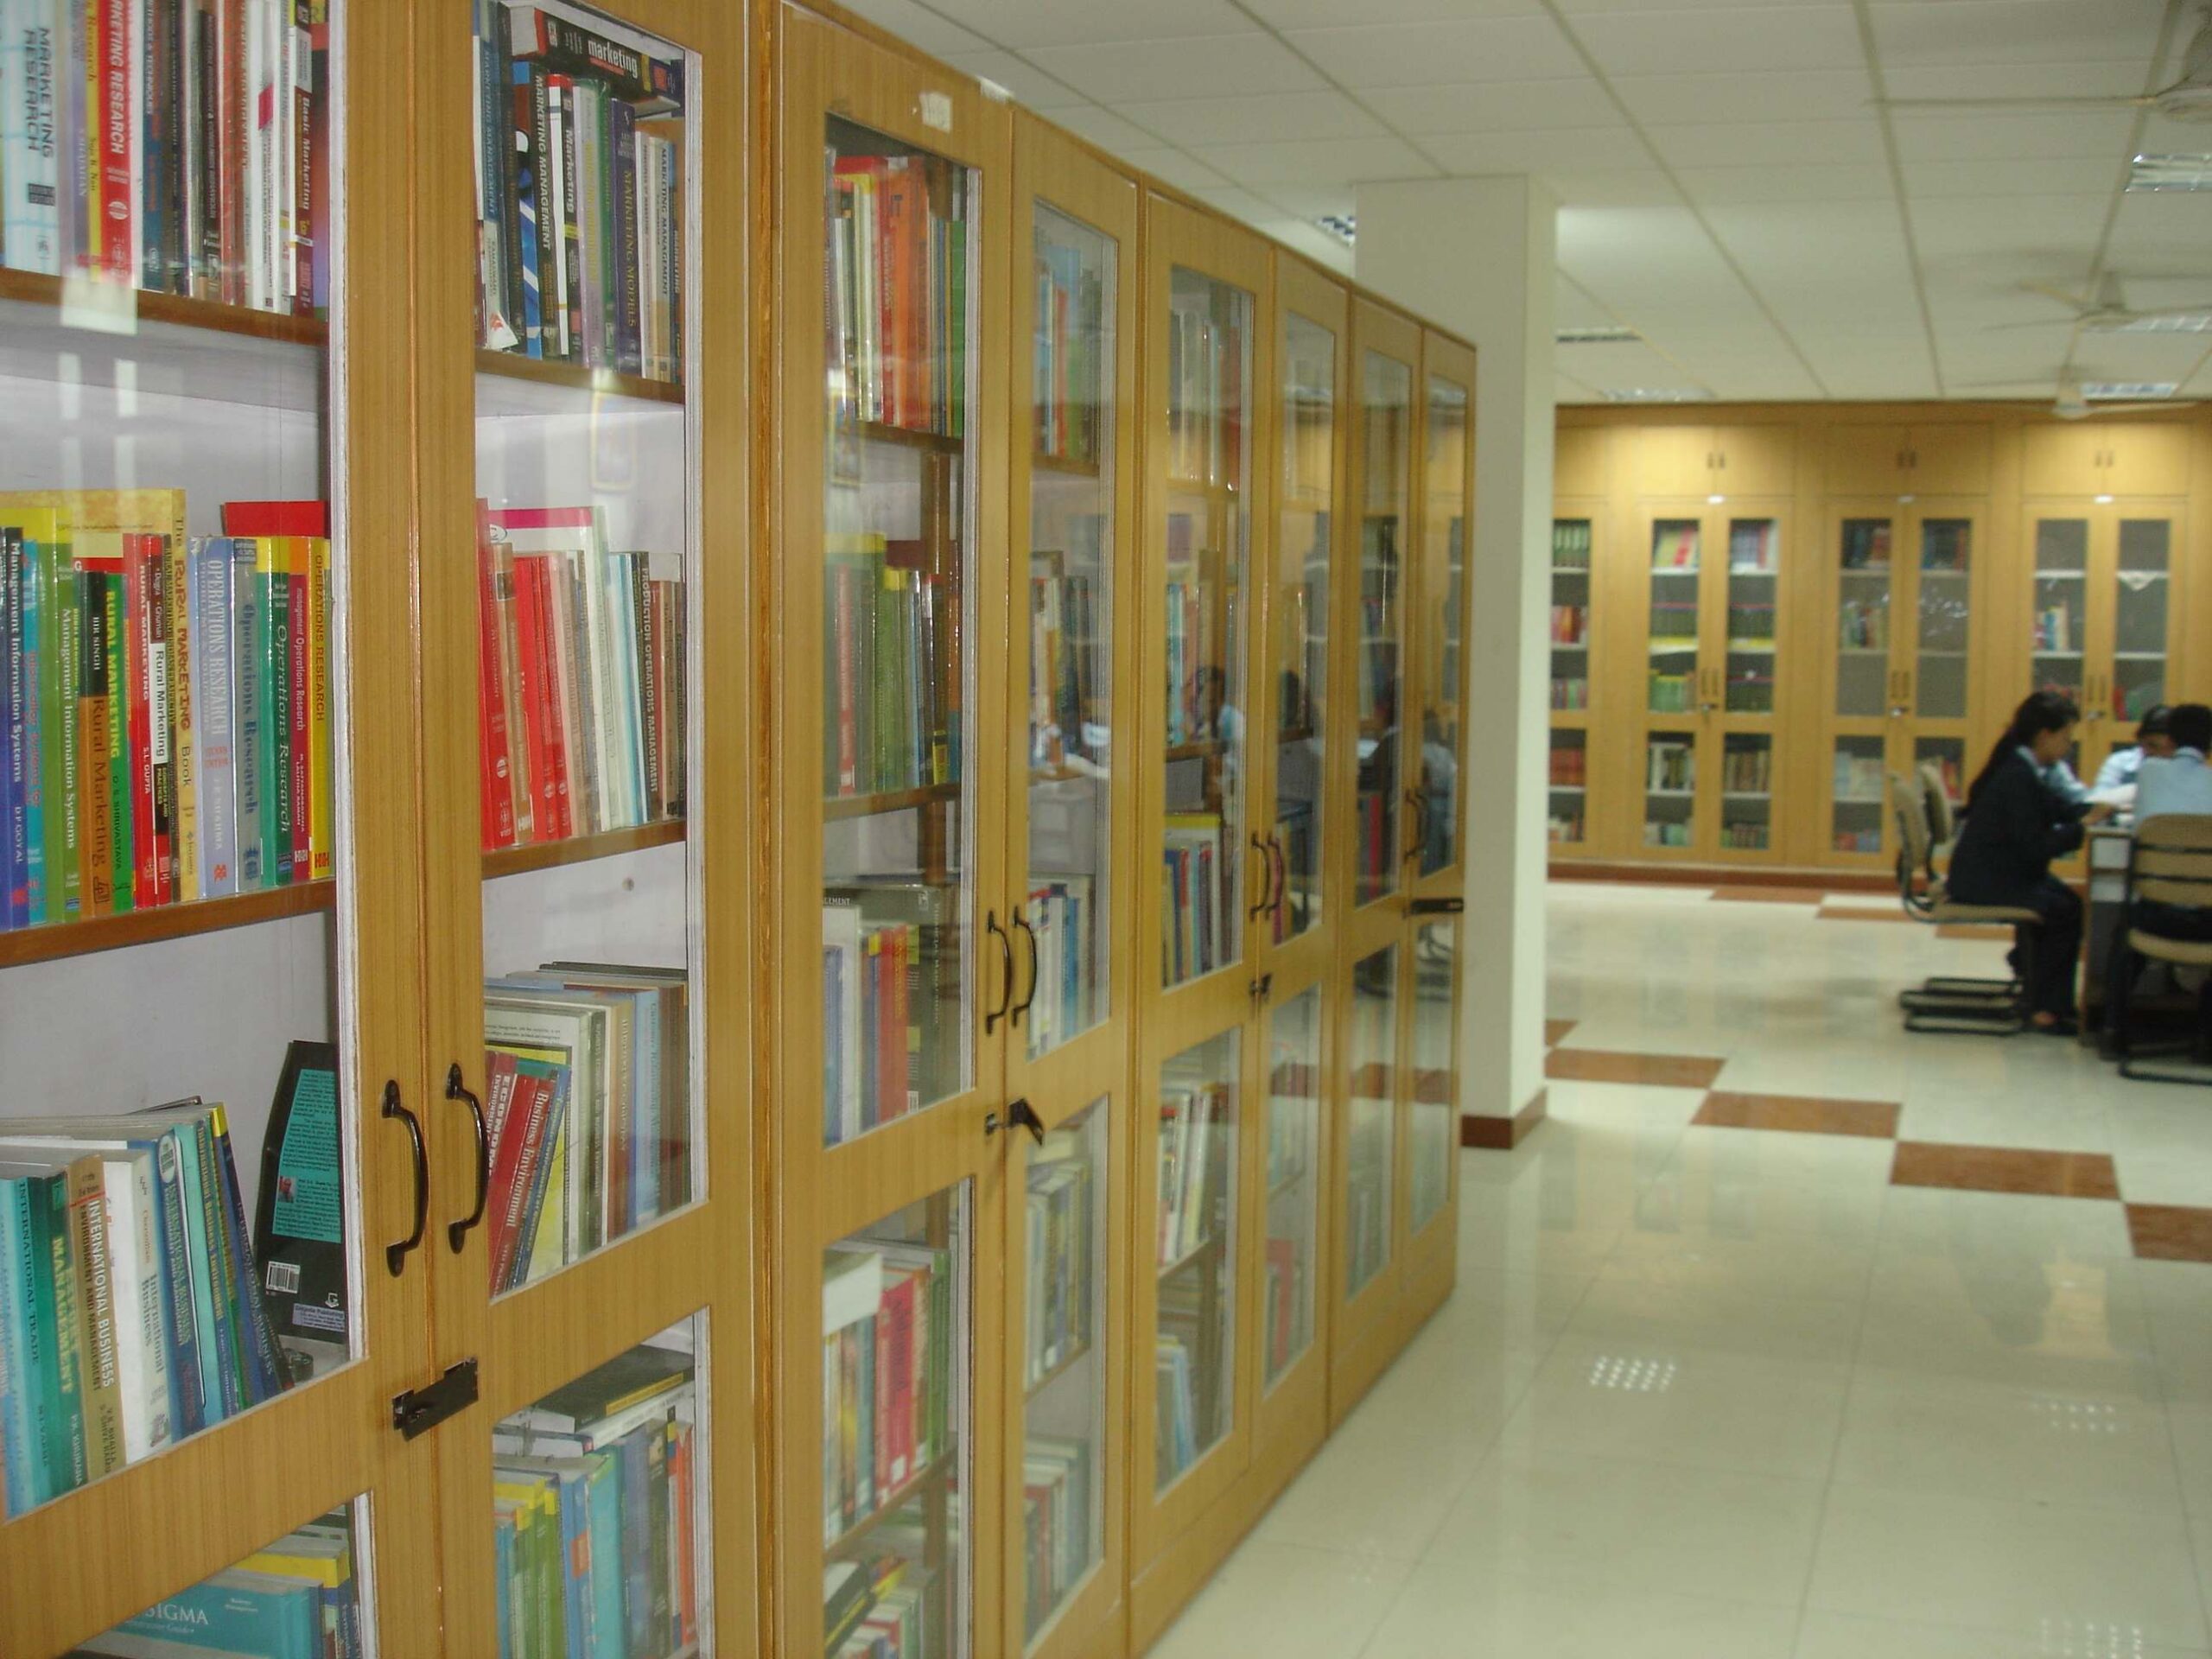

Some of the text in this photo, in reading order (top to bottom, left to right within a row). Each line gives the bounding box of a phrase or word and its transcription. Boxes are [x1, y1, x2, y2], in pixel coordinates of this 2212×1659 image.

[24, 29, 39, 151] RESEARCH
[39, 28, 54, 158] MARKETING
[588, 40, 639, 79] marketing
[110, 70, 124, 155] RESEARCH
[301, 97, 312, 210] Basic Marketing
[535, 75, 546, 153] MARKETING
[540, 156, 551, 251] MANAGEMENT
[564, 129, 576, 214] Marketing
[660, 147, 670, 296] MARKETING MANAGEMENT
[624, 169, 638, 327] MARKETING MODELS
[173, 516, 186, 548] The
[92, 616, 101, 671] BIR SINGH
[154, 572, 163, 638] Dogra Ghuman
[207, 559, 226, 654] OPERATIONS
[314, 554, 326, 722] OPERATIONS RESEARCH
[10, 542, 23, 783] Management Information Systems
[106, 591, 120, 759] RURAL MARKETING
[141, 615, 150, 701] MARKETING
[155, 650, 167, 757] Rural Marketing
[177, 627, 191, 731] MARKETING
[208, 657, 228, 734] RESEARCH
[239, 603, 258, 814] Operations Research
[293, 637, 306, 688] Operations
[641, 567, 658, 793] PRODUCTION OPERATIONS MANAGEMENT
[61, 607, 78, 849] Management Information Systems
[275, 624, 292, 832] Operations Research
[296, 689, 306, 731] Research
[92, 699, 110, 868] Rural Marketing
[143, 765, 152, 794] GUPTA
[181, 745, 194, 786] Book
[489, 1075, 511, 1177] ECONOM
[505, 1091, 550, 1228] Business Environment
[18, 1180, 40, 1365] INTERNATIONAL TRADE
[203, 1201, 216, 1250] Business
[53, 1236, 73, 1394] MANAGEMENT
[79, 1202, 102, 1390] ENVIRONMENT AND MANAGEMENT
[89, 1199, 114, 1387] INTERNATIONAL BUSINESS
[141, 1279, 154, 1347] Business
[149, 1273, 164, 1374] International
[144, 1604, 209, 1625] SIGMA
